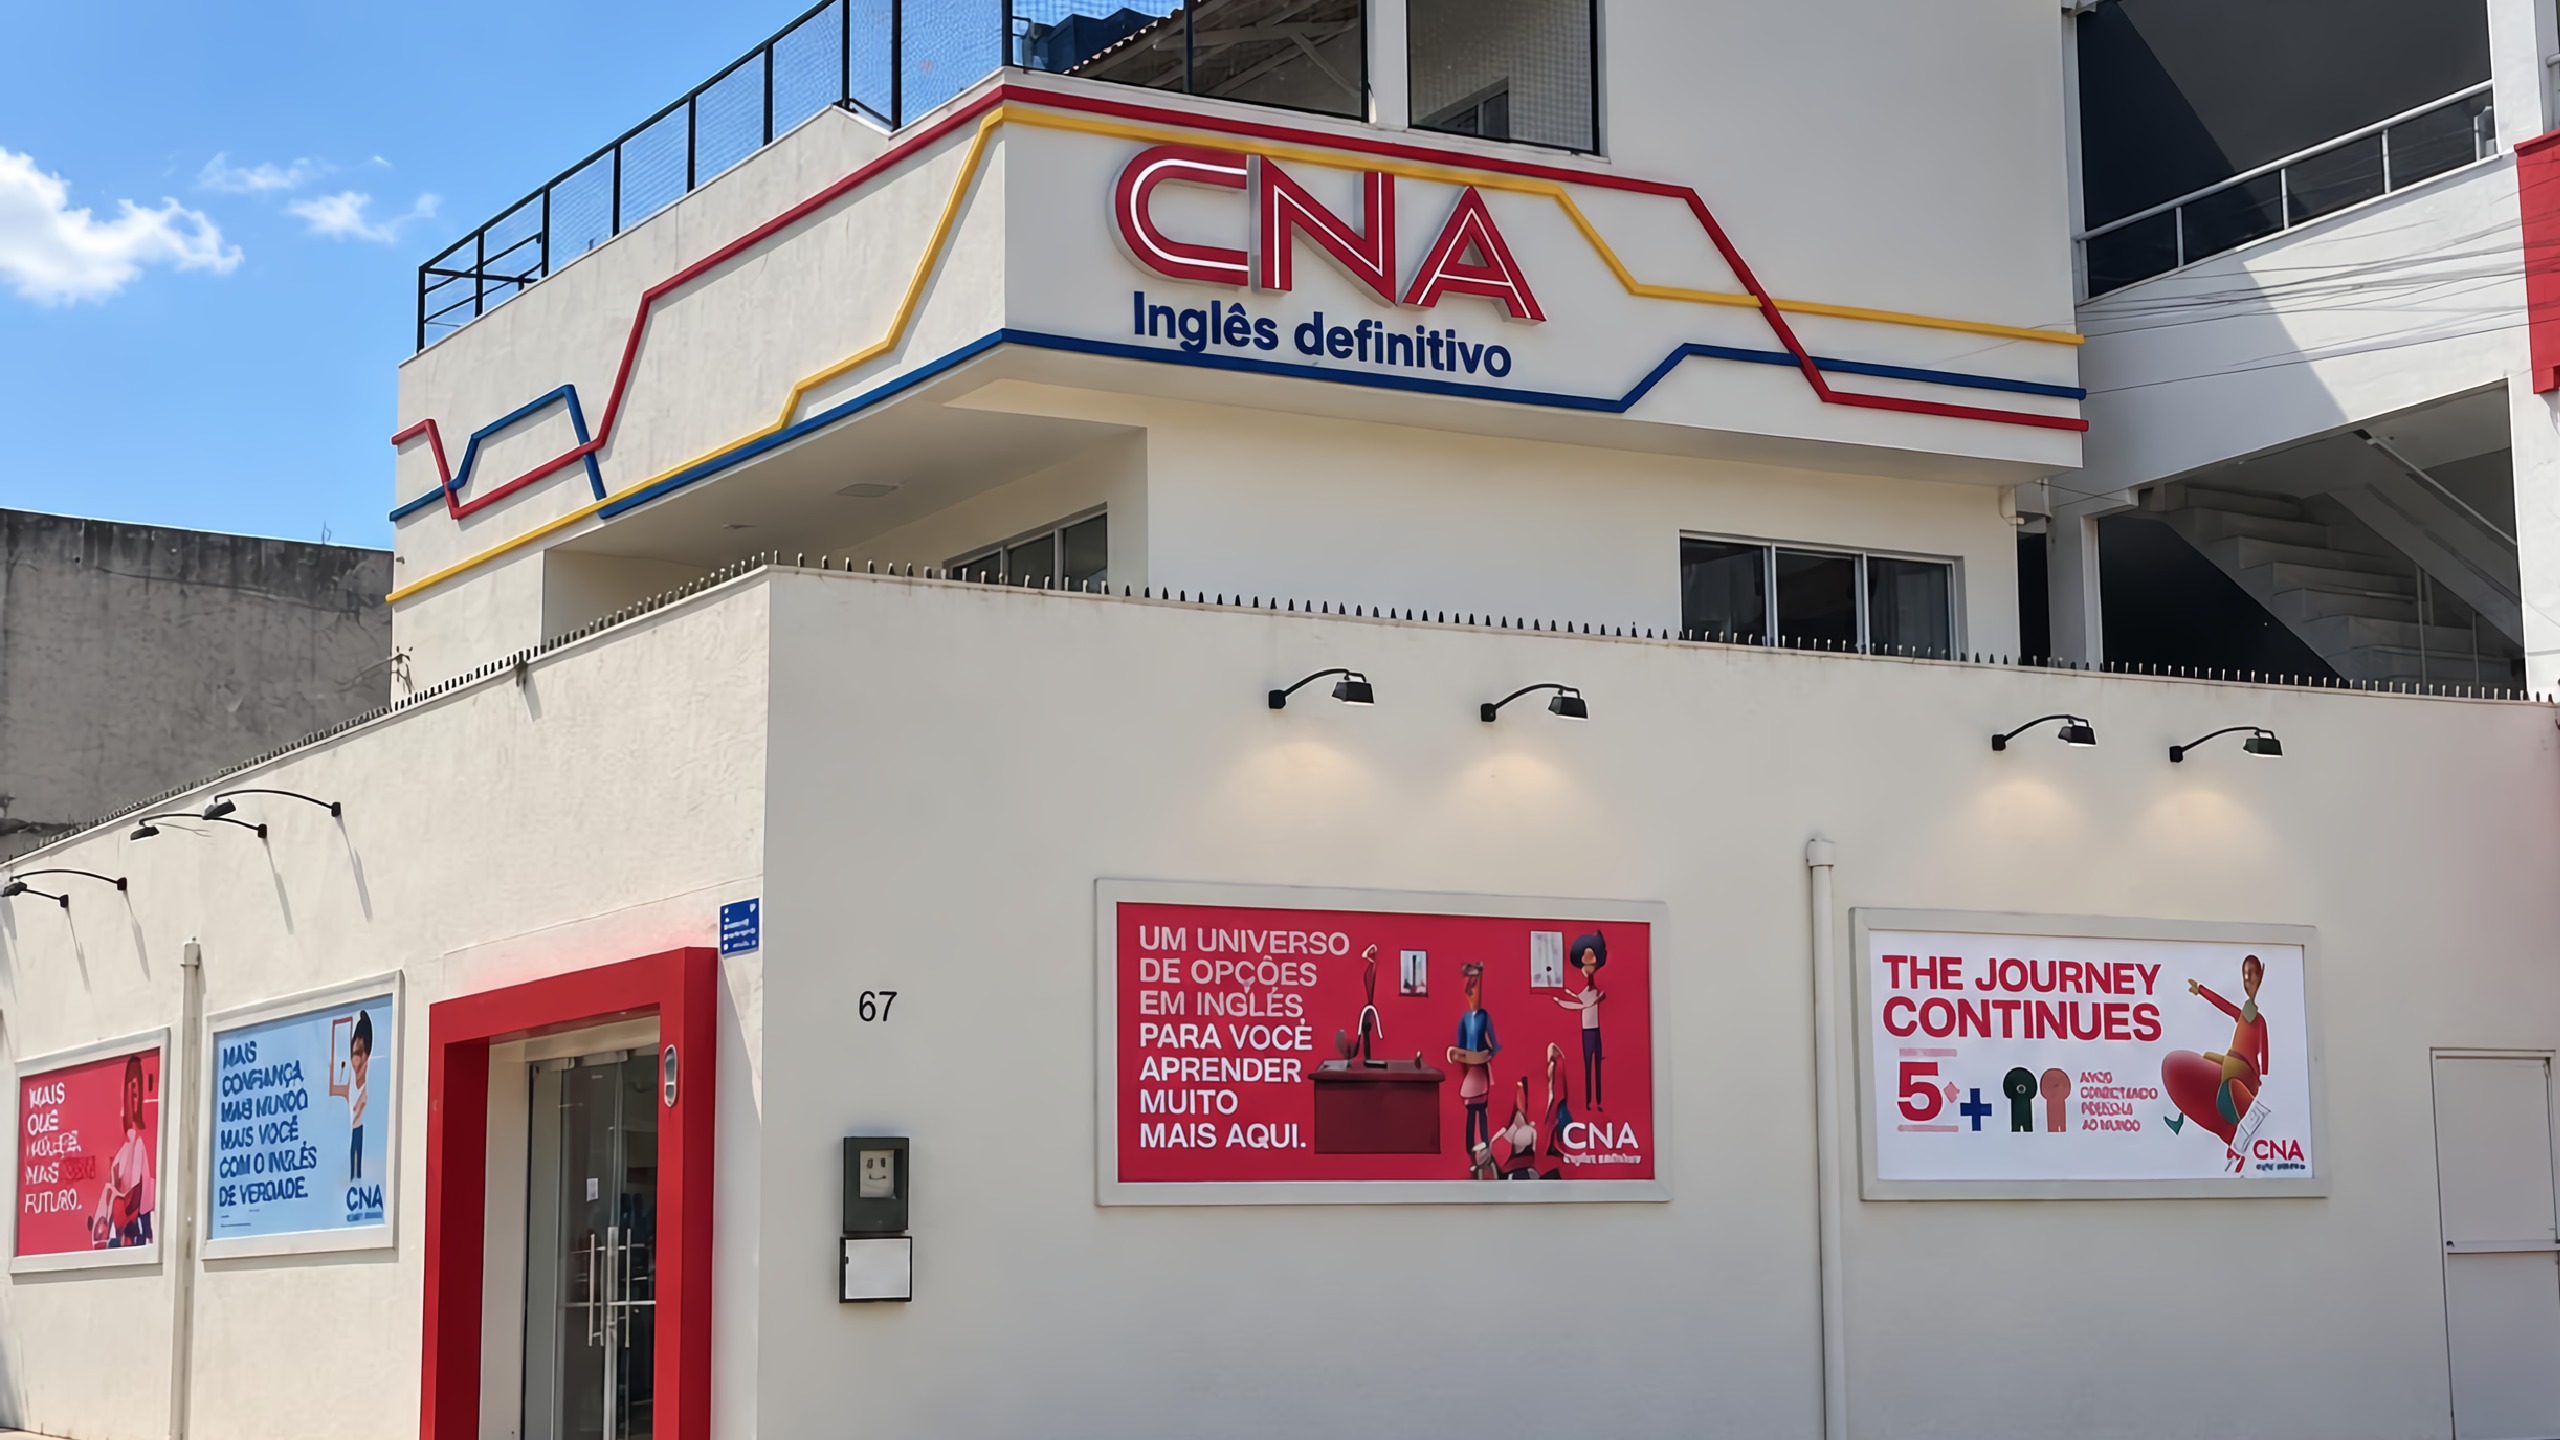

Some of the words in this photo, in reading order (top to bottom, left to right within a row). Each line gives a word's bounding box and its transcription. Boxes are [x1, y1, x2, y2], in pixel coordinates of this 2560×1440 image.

[1113, 144, 1547, 322] CNA
[1133, 291, 1278, 353] Inglês
[1294, 311, 1512, 378] definitivo
[1139, 925, 1186, 951] UM
[1197, 928, 1350, 956] UNIVERSO
[1140, 957, 1181, 984] DE
[1882, 955, 1963, 990] THE
[1975, 957, 2161, 995] JOURNEY
[858, 990, 897, 1022] 67
[1140, 990, 1185, 1015] EM
[1883, 996, 2162, 1042] CONTINUES
[1140, 1022, 1222, 1049] PARA
[1139, 1056, 1302, 1083] APRENDER
[1140, 1089, 1238, 1115] MUITO
[1897, 1061, 1944, 1122] 5
[1140, 1123, 1217, 1148] MAIS
[1225, 1123, 1307, 1149] AQUI.
[1562, 1121, 1639, 1149] CNA
[2253, 1139, 2305, 1161] CNA
[219, 1185, 237, 1207] DE
[346, 1183, 384, 1212] CNA
